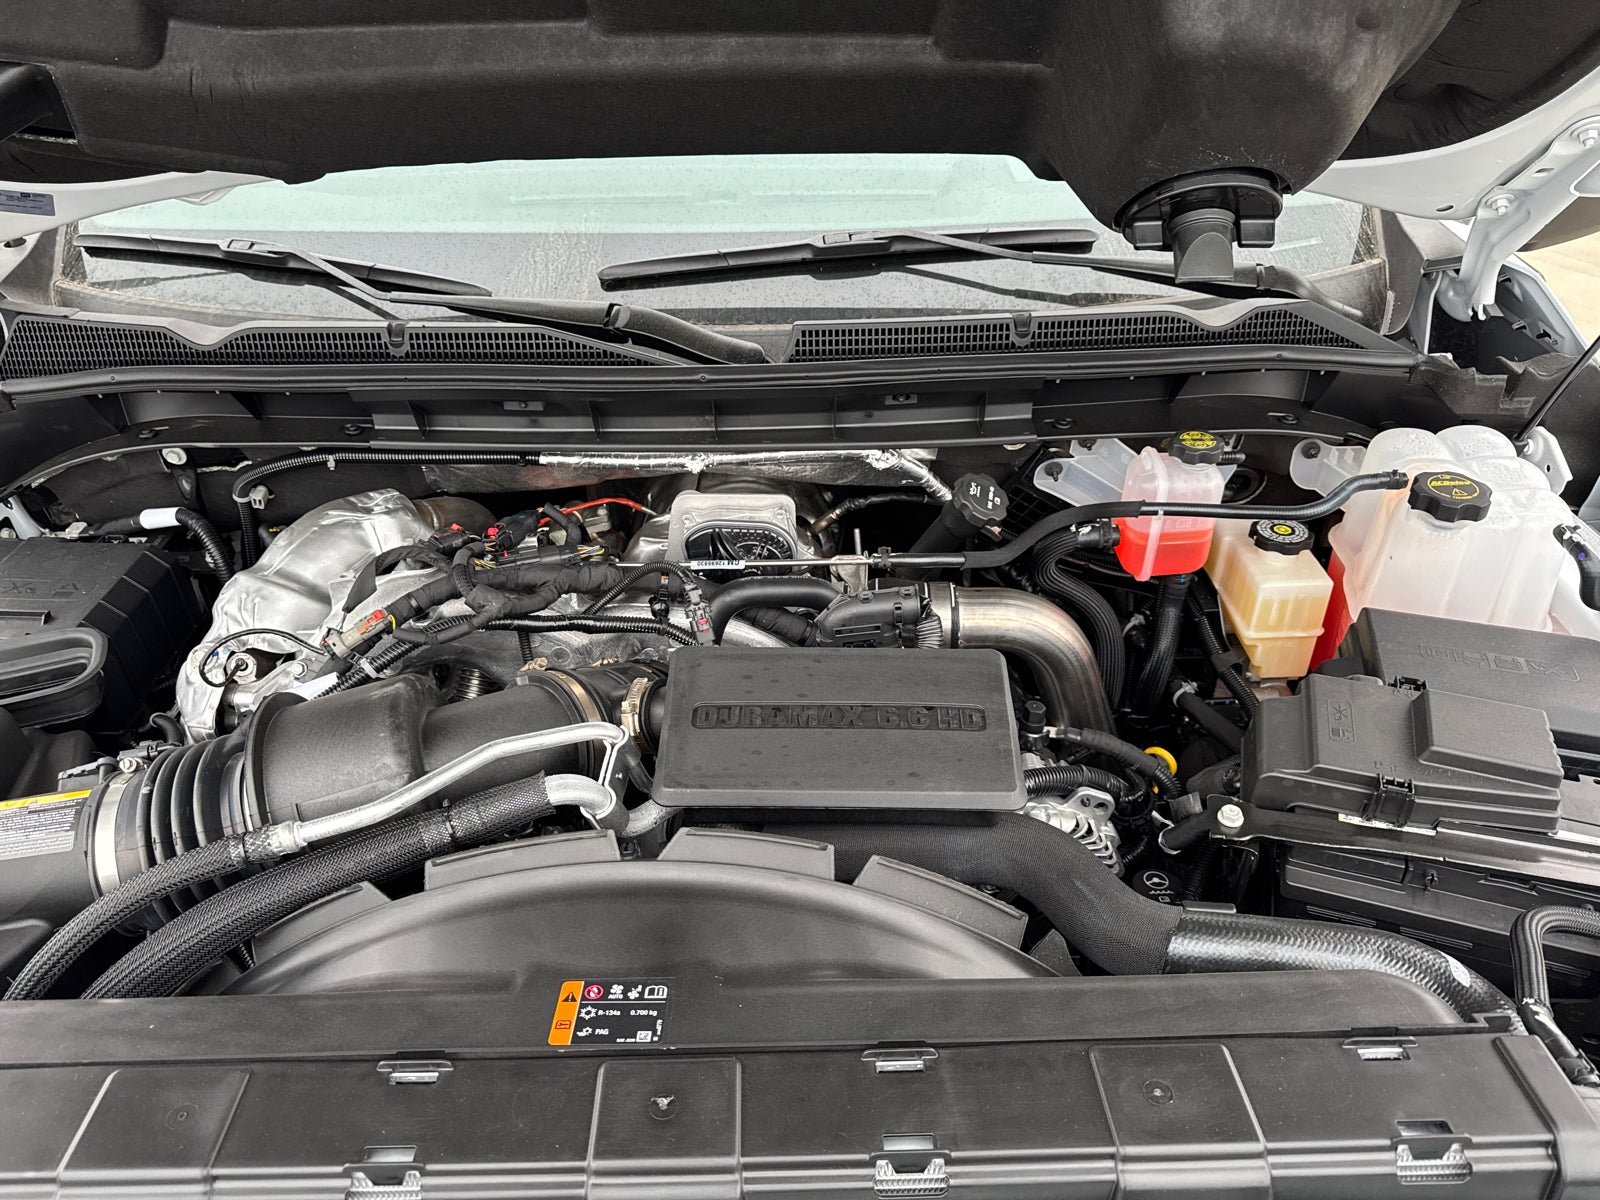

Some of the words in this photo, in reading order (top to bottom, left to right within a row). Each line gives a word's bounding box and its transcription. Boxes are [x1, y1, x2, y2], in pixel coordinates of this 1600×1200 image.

[696, 705, 863, 729] DURAMAX
[877, 705, 930, 729] 6.6
[938, 708, 983, 731] HD
